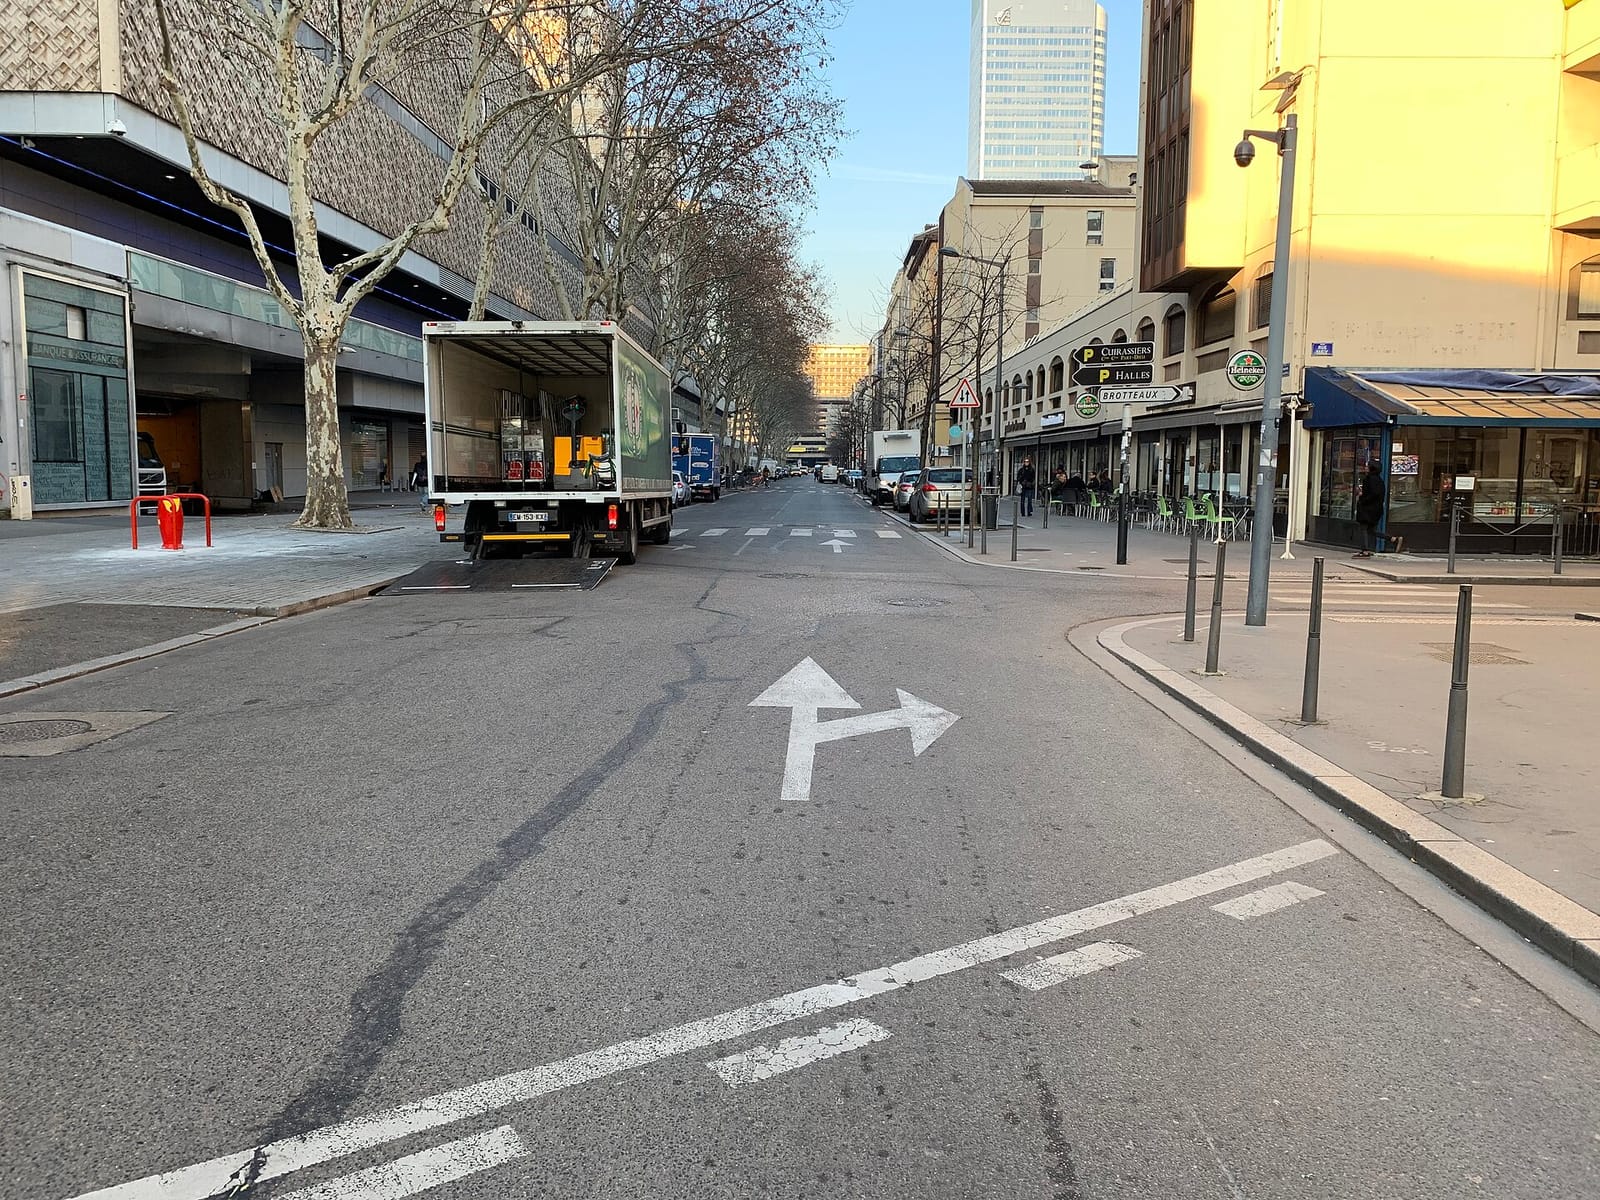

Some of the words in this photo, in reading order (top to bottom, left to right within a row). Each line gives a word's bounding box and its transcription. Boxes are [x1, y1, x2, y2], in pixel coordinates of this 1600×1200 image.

[33, 344, 67, 358] BANQUE
[1101, 346, 1151, 355] CUIRASSIERS
[1115, 370, 1151, 380] HALLES
[1230, 366, 1264, 374] Heineken
[1102, 390, 1158, 400] BROTTEAUX
